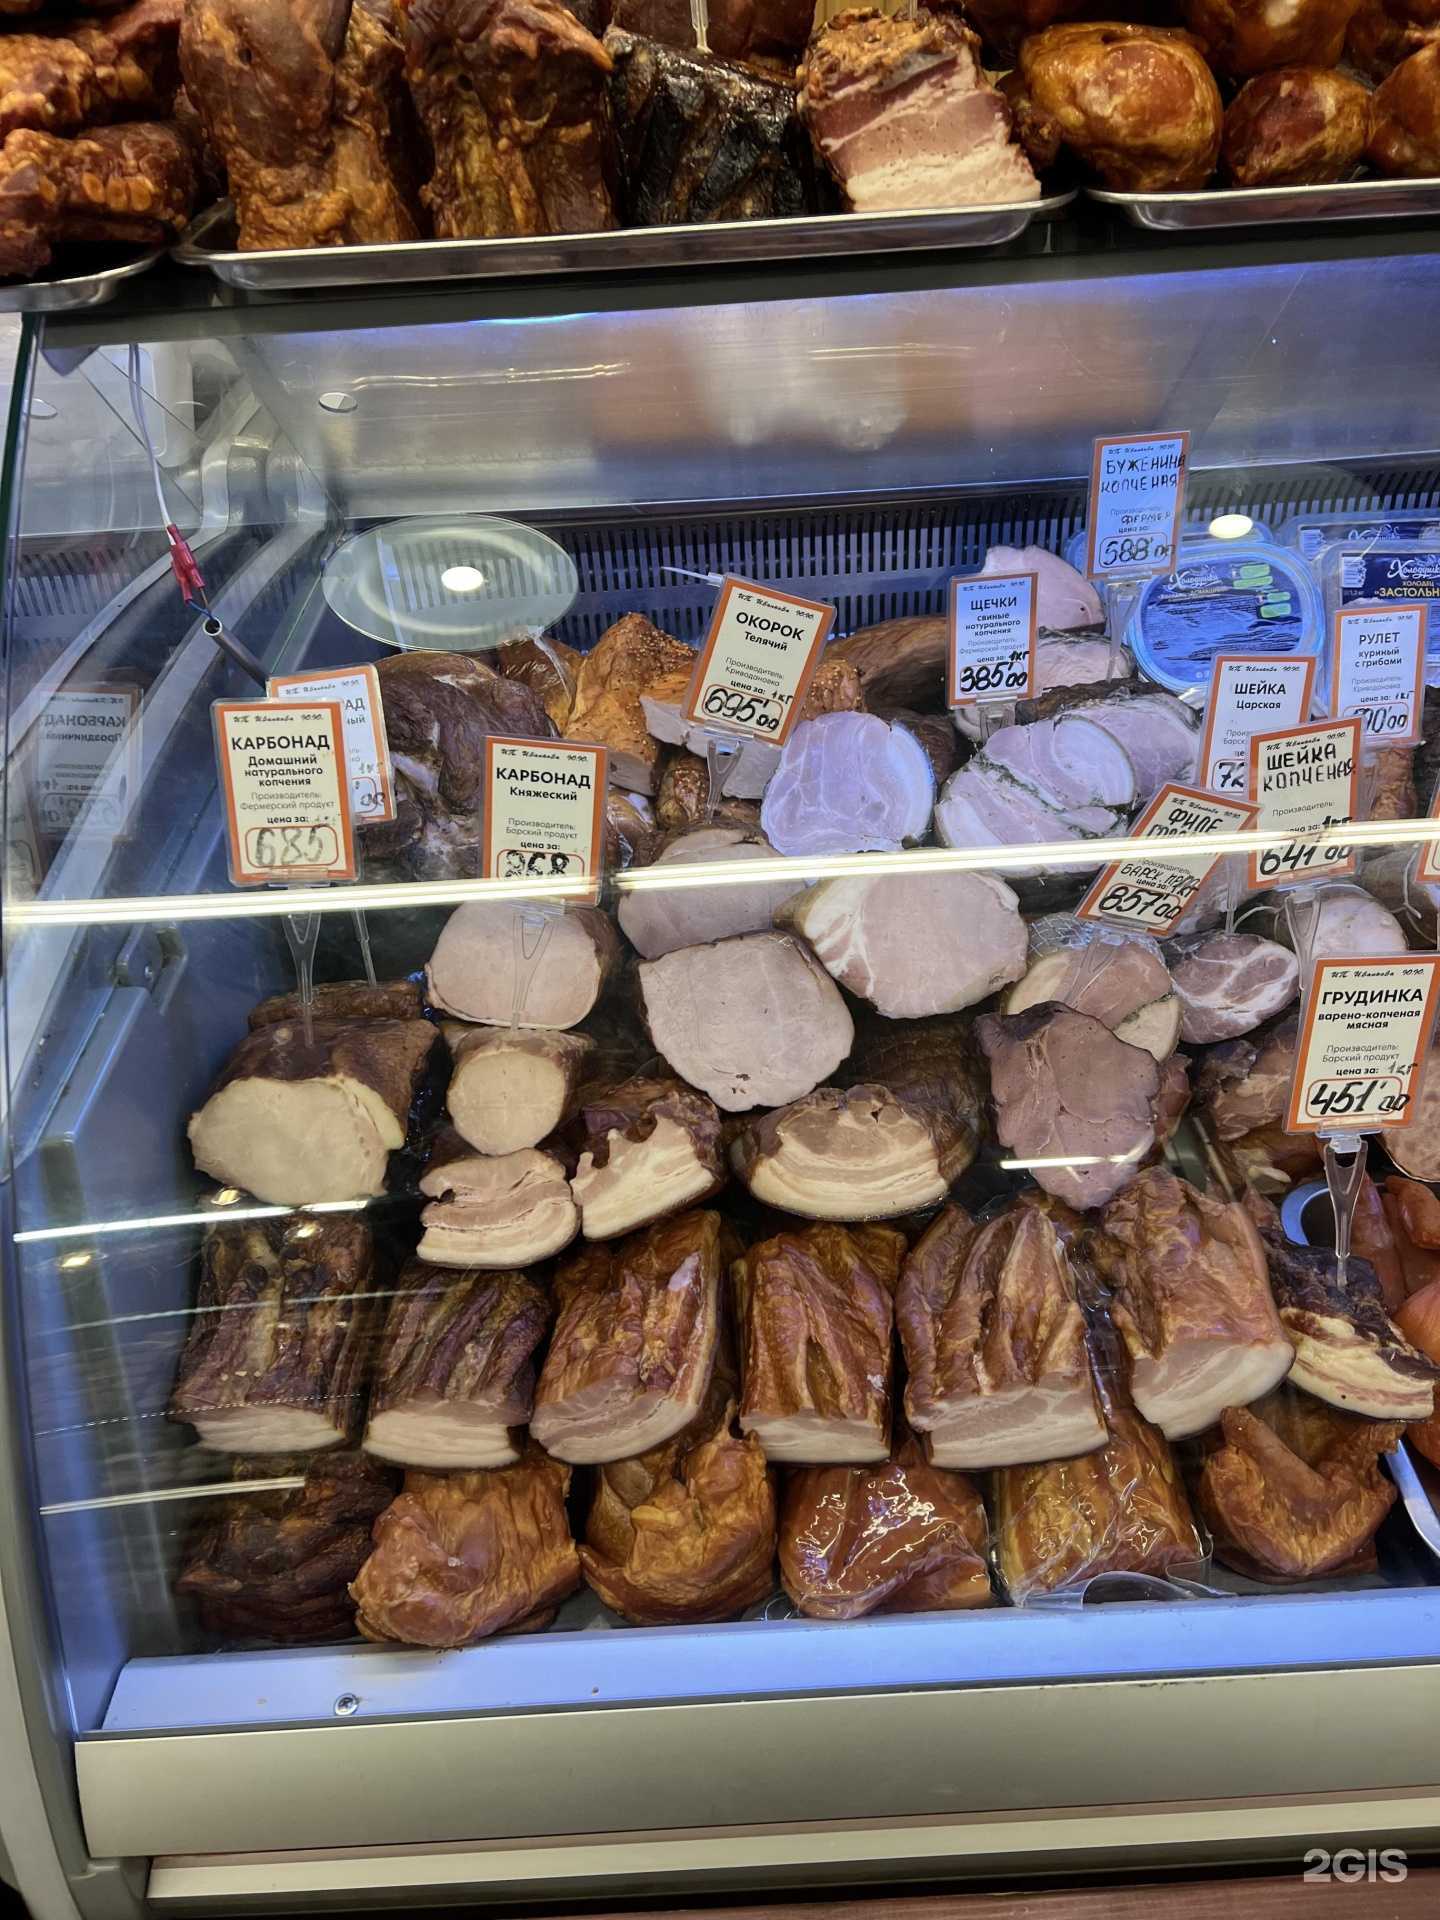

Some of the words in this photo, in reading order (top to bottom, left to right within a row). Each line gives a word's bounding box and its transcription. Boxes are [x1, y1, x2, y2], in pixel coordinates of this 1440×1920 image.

[971, 597, 1017, 611] ЩЕЧКИ
[977, 613, 1009, 621] свиные
[736, 612, 805, 641] ОКОРОК
[966, 620, 1020, 630] натурального
[975, 628, 1011, 637] копчения
[745, 632, 787, 651] Телячий
[1360, 633, 1400, 644] РУЛЕТ
[1359, 647, 1399, 658] куриный
[726, 657, 784, 679] Производитель:
[1362, 659, 1402, 668] грибами
[731, 680, 751, 690] цена
[753, 686, 766, 695] за:
[1235, 680, 1286, 694] ШЕЙКА
[1237, 700, 1281, 710] Царская
[232, 735, 330, 750] КАРБОНАД
[248, 756, 318, 768] Домашний
[1267, 743, 1336, 771] ШЕЙКА
[245, 767, 323, 778] натурального
[496, 767, 591, 789] КАРБОНАД
[1263, 758, 1355, 792] КОПЧЕНАЯ
[259, 778, 311, 787] копчения
[510, 787, 577, 801] Княжеский
[1272, 801, 1335, 816] Производитель:
[267, 816, 292, 824] цена
[1168, 808, 1223, 833] ФИЛЕ
[521, 841, 544, 849] цена
[1136, 878, 1156, 888] цена
[1322, 989, 1423, 1007] ГРУДИНКА
[1318, 1010, 1420, 1021] варено-копченая
[1347, 1021, 1388, 1030] мясная
[1326, 1043, 1399, 1053] Производитель:
[1322, 1053, 1361, 1062] Барский
[1363, 1053, 1399, 1062] продукт
[1336, 1068, 1362, 1076] цена
